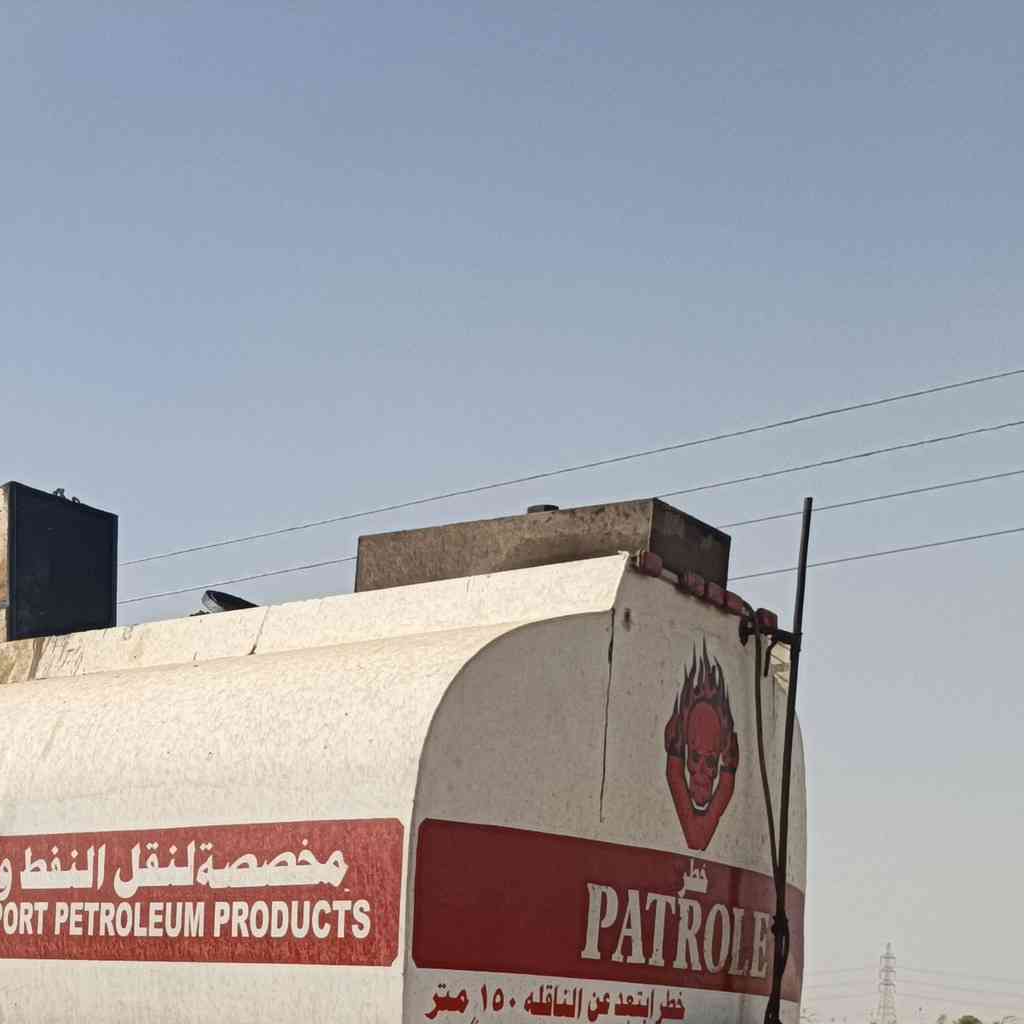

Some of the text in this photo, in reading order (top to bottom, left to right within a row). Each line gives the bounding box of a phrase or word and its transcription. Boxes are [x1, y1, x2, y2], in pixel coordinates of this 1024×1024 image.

[20, 842, 106, 892] النفط
[54, 901, 205, 937] PETROLEUM
[214, 900, 371, 939] PRODUCTS
[581, 882, 773, 978] PATROLE
[424, 982, 469, 1020] متر
[480, 983, 517, 1012] ١٥٠
[587, 991, 611, 1023] عن
